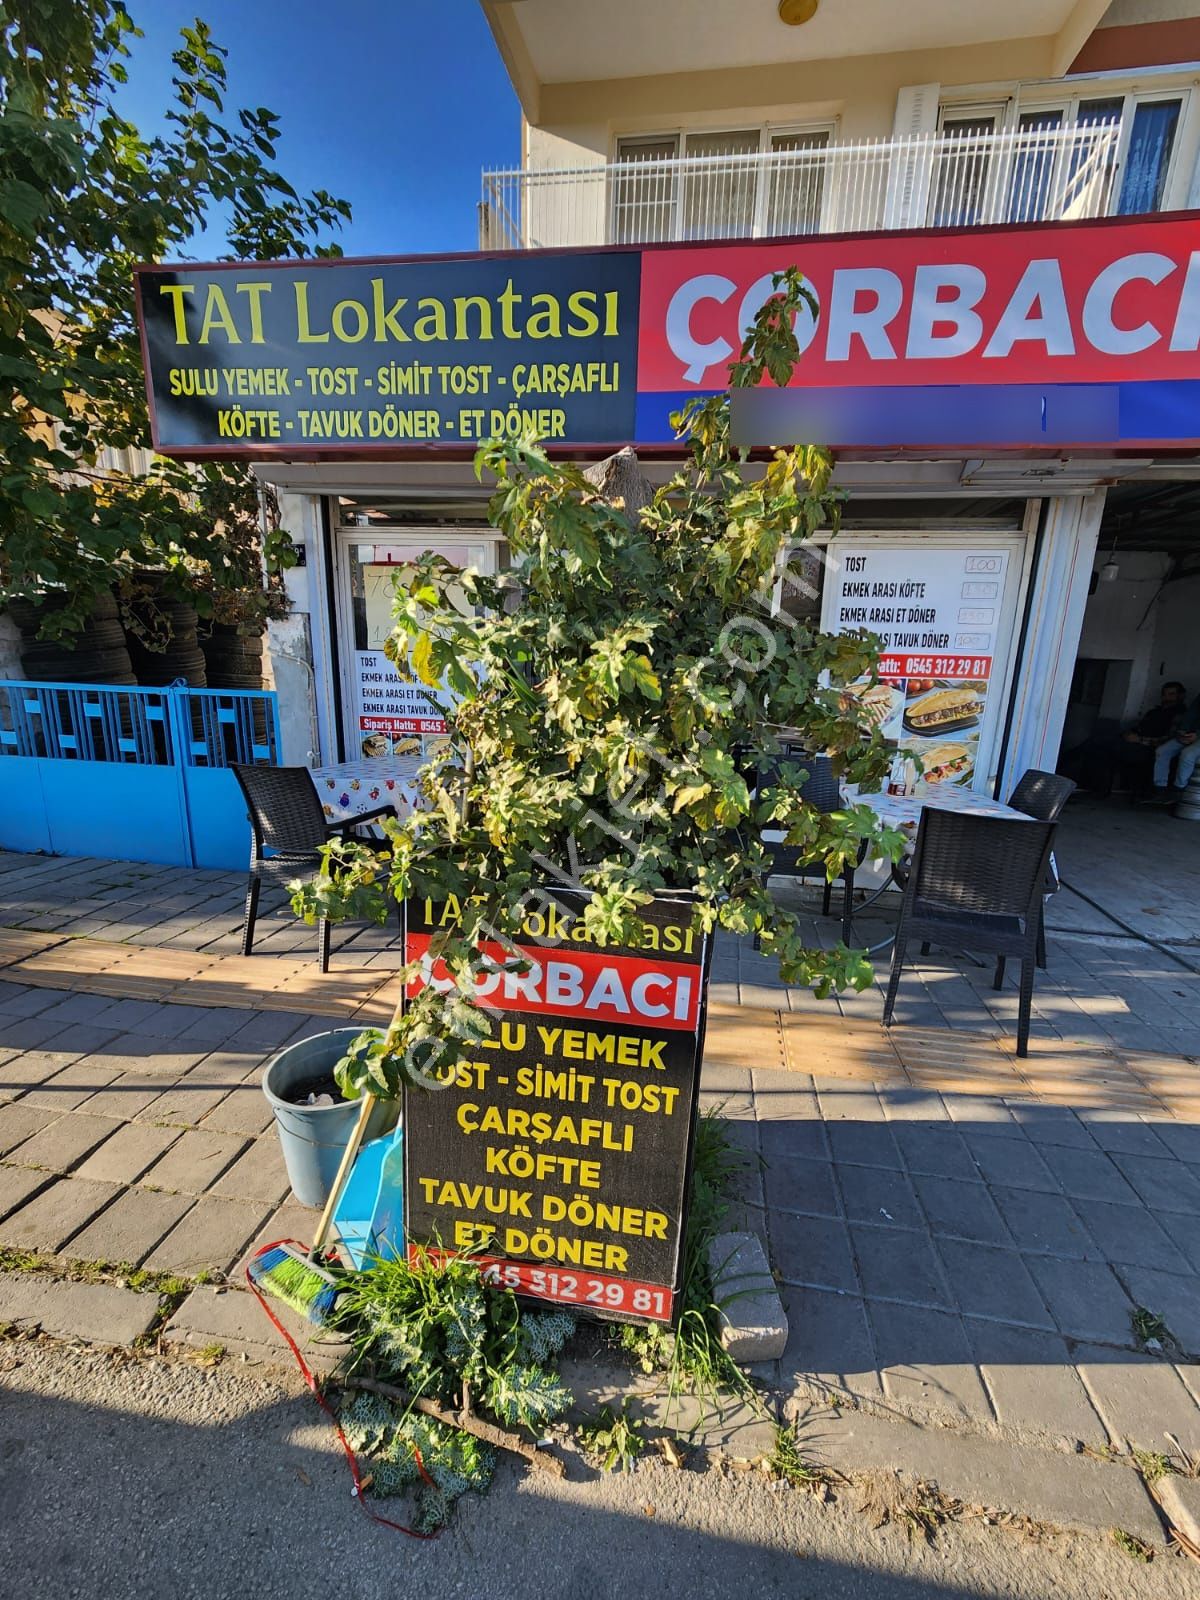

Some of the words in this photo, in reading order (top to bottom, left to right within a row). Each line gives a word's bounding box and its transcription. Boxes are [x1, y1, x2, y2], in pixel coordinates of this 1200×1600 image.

[160, 281, 272, 345] TAT
[294, 277, 619, 343] Lokantası
[169, 367, 219, 397] SULU
[223, 367, 290, 397] YEMEK
[306, 366, 359, 396] TOST
[377, 360, 436, 396] SİMİT
[438, 365, 493, 395] TOST
[512, 362, 619, 399] ÇARŞAFLI
[218, 404, 280, 438] KÖFTE
[298, 409, 364, 438] TAVUK
[368, 403, 440, 438] DÖNER
[459, 410, 485, 438] ET
[491, 402, 566, 438] DÖNER
[845, 556, 867, 572] TOST
[842, 581, 871, 598] EKMEK
[872, 582, 898, 598] ARASI
[899, 578, 926, 599] KÖFTE
[840, 607, 868, 623] EKMEK
[869, 607, 894, 623] ARASI
[896, 608, 907, 623] ET
[908, 604, 936, 624] DÖNER
[893, 632, 919, 648] TAVUK
[921, 629, 950, 649] DÖNER
[360, 657, 377, 667] TOST
[906, 656, 933, 674] 0545
[935, 658, 955, 675] 312
[957, 659, 972, 675] 29
[972, 660, 986, 676] 81
[361, 672, 383, 682] EKMEK
[362, 688, 383, 698] EKMEK
[386, 689, 405, 699] ARASI
[406, 689, 414, 699] ET
[363, 703, 384, 713] EKMEK
[387, 704, 406, 714] ARASI
[408, 705, 428, 715] TAVUK
[364, 718, 392, 730] Sipariş
[420, 720, 441, 732] 0545
[536, 1025, 668, 1071] YEMEK
[436, 1060, 490, 1090] OST
[515, 1063, 595, 1102] SİMİT
[603, 1077, 680, 1115] TOST
[456, 1103, 634, 1152] ÇARŞAFLI
[485, 1144, 601, 1189] KÖFTE
[419, 1177, 532, 1218] TAVUK
[542, 1193, 668, 1240] DÖNER
[454, 1220, 496, 1249] ET
[505, 1226, 629, 1272] DÖNER
[529, 1267, 577, 1299] 312
[586, 1279, 624, 1306] 29
[632, 1287, 664, 1315] 81
